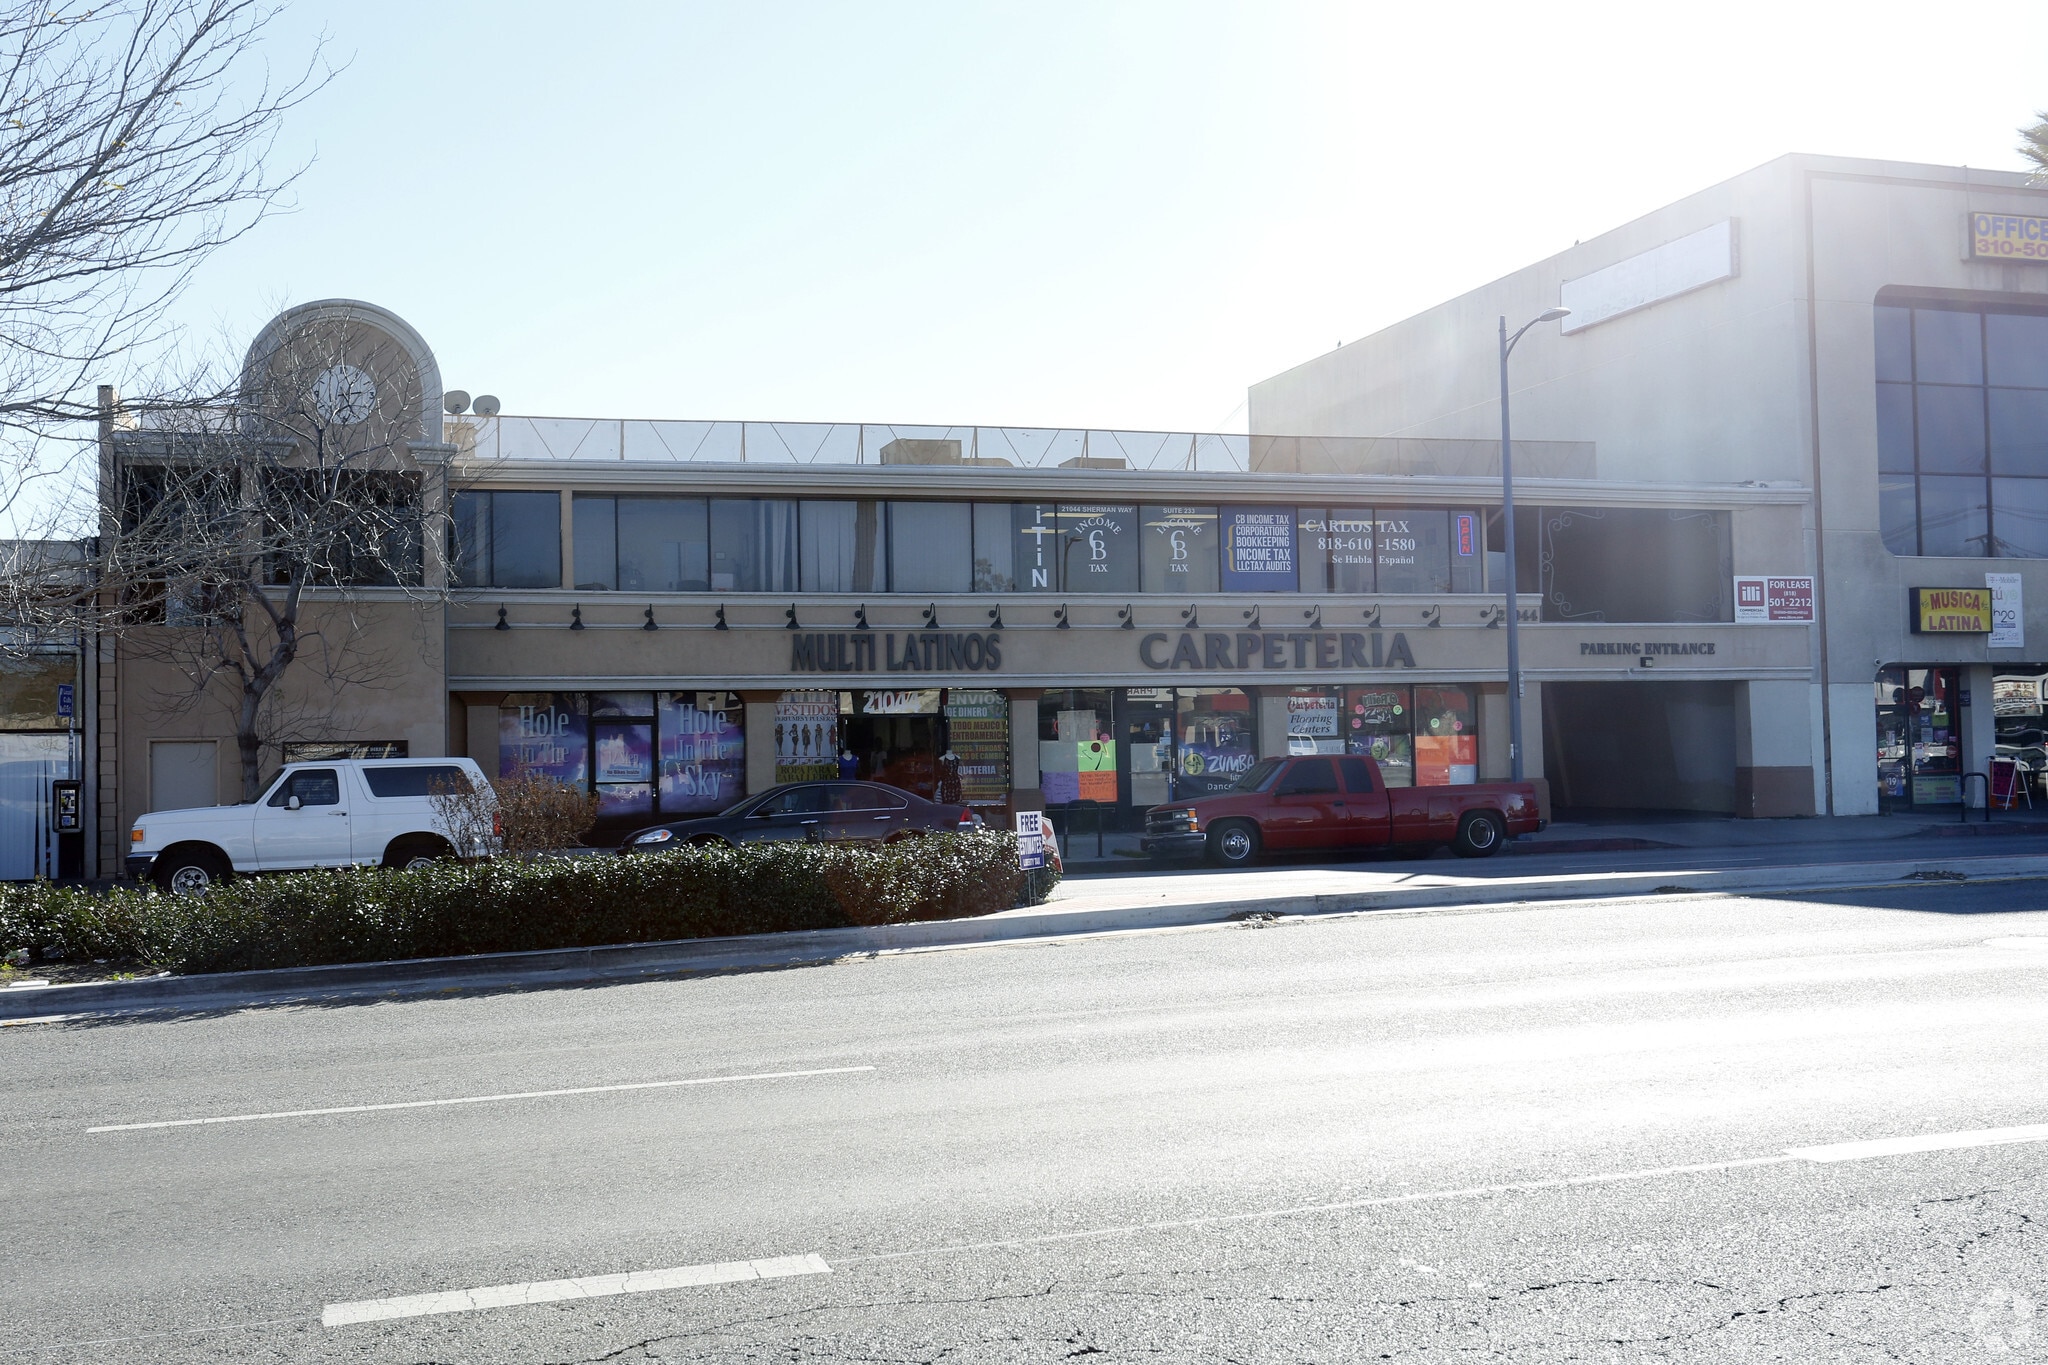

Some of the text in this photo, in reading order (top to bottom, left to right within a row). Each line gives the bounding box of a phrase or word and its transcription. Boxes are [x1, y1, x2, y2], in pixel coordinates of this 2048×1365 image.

[1975, 215, 2048, 241] OFFICE
[1977, 239, 2048, 258] 310-50
[1235, 514, 1289, 525] CB INCOME TAX
[1075, 517, 1122, 535] INCOME
[1235, 526, 1289, 536] CORPORATIONS
[1305, 519, 1410, 533] CARLOS TAX
[1460, 517, 1470, 553] OPEN
[1236, 536, 1290, 547] BOOKKEEPING
[1318, 537, 1372, 551] 818-610
[1236, 548, 1290, 561] INCOME TAX
[1331, 554, 1414, 566] Se Habla Español
[1089, 564, 1108, 573] TAX
[1170, 563, 1188, 572] TAX
[1250, 561, 1265, 571] TAX
[1265, 561, 1291, 571] AUDITS
[1769, 580, 1810, 589] FOR LEASE
[1769, 598, 1812, 607] 501-2212
[1930, 591, 1981, 611] MUSICA
[1497, 609, 1538, 621] 244
[1928, 615, 1982, 630] LATINA
[791, 633, 1001, 671] MULTI LATINOS
[1139, 632, 1417, 669] CARPETERIA
[1580, 643, 1715, 655] PARKING ENTRANCE
[948, 693, 1006, 705] ENVIOS
[775, 704, 837, 716] VESTIDOS
[947, 706, 988, 717] DE DINERO
[519, 705, 569, 738] Hole
[679, 703, 727, 734] Hole
[1291, 714, 1332, 725] Flooring
[953, 721, 972, 730] TODO
[973, 721, 1000, 730] MEXICO
[1292, 725, 1330, 734] Centers
[540, 741, 570, 764] The
[680, 739, 727, 760] In The
[980, 752, 1006, 760] CAMBIO
[1207, 754, 1255, 773] ZUMBA
[781, 766, 831, 774] ROPA PARA
[957, 765, 996, 775] QUETERIA
[687, 765, 722, 800] Sky
[1021, 814, 1038, 832] FREE
